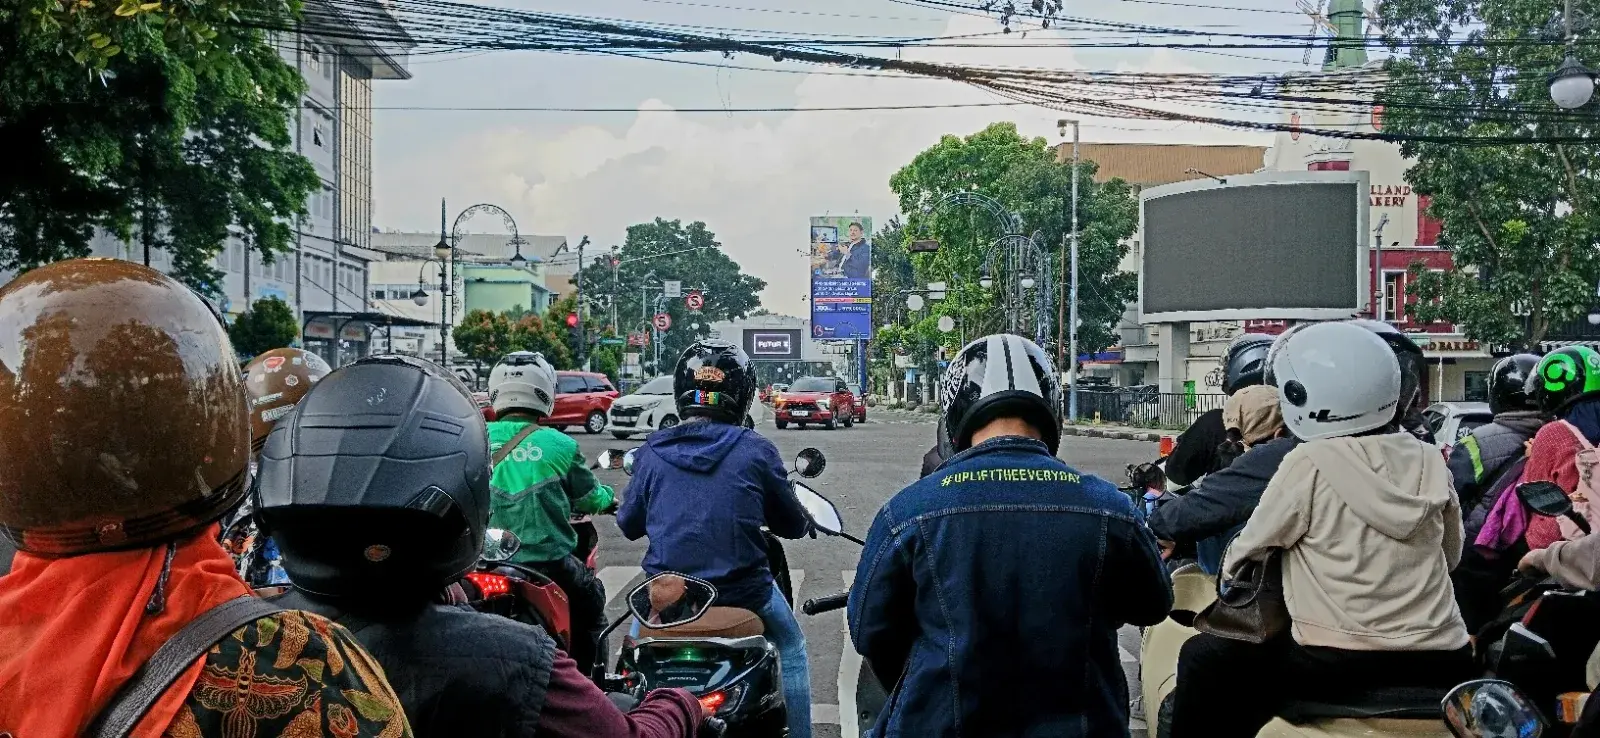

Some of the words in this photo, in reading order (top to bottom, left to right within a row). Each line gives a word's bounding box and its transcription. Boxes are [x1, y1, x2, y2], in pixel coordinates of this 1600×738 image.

[1370, 184, 1411, 196] LLAND
[1369, 196, 1406, 207] AKERY
[940, 468, 1081, 487] #UPLIFTTHEEVERYDAY
